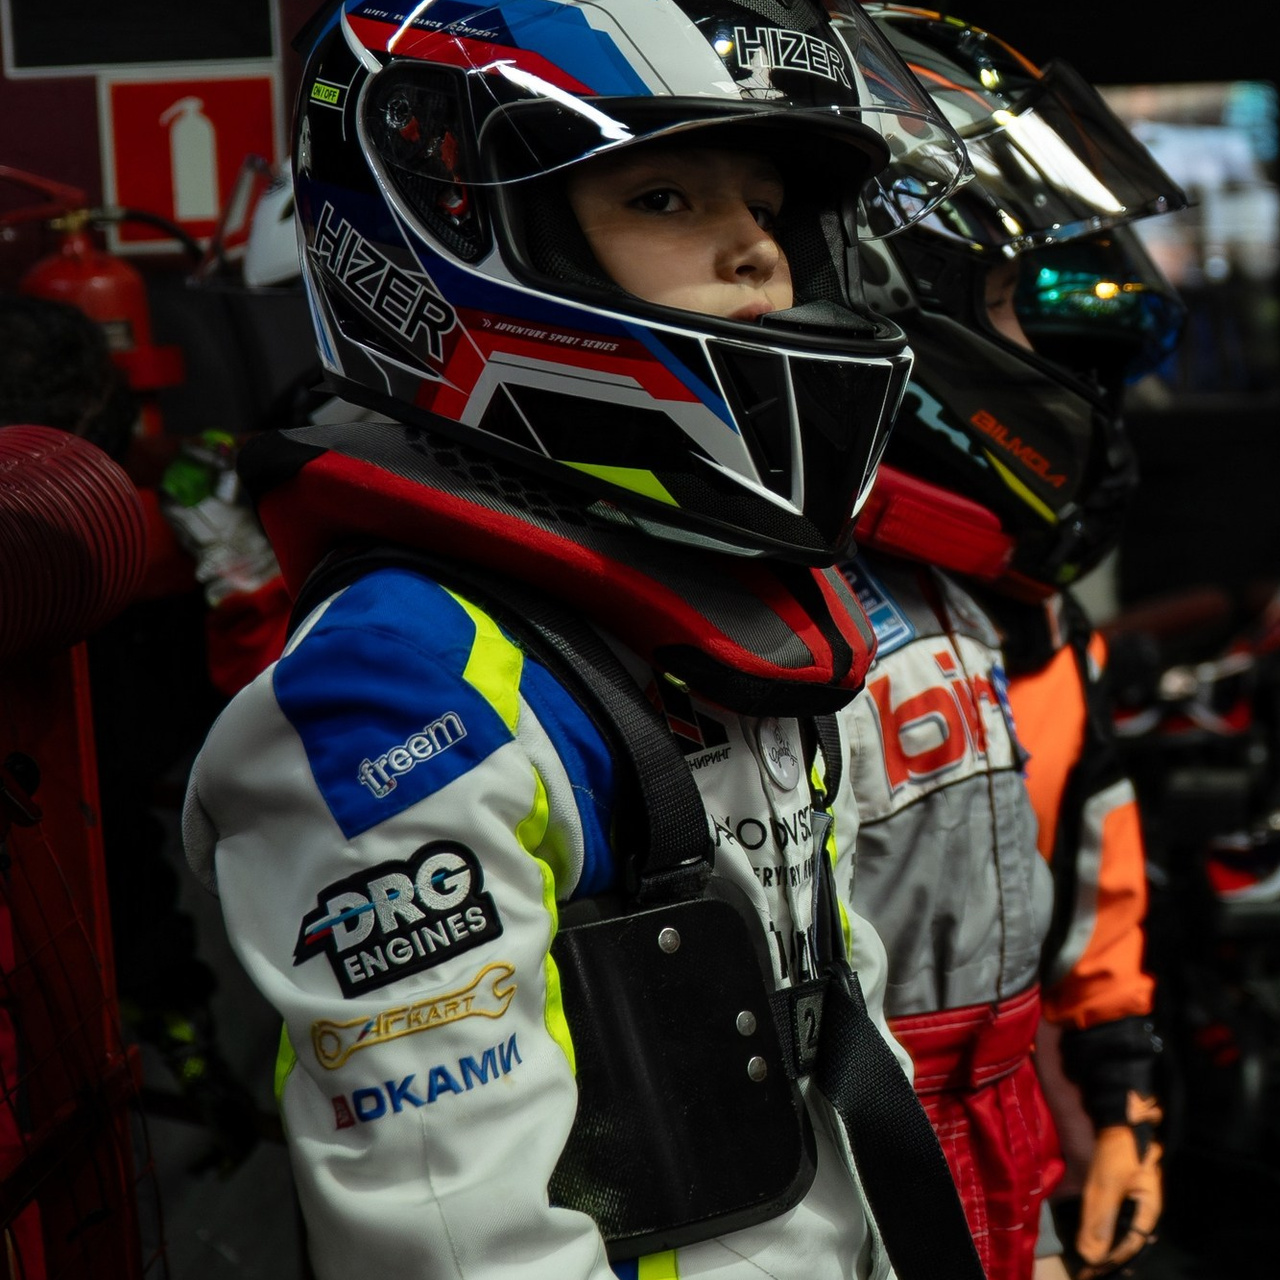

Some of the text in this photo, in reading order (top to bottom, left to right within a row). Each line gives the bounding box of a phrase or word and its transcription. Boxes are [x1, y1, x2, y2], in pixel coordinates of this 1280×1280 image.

[733, 26, 852, 89] HIZER
[313, 200, 457, 363] HIZER
[494, 321, 620, 352] ADVENTURE SPORT SERIES
[359, 712, 466, 798] freem
[688, 746, 732, 772] НИРИНГ
[325, 852, 472, 954] DRG
[342, 905, 487, 985] ENGINES
